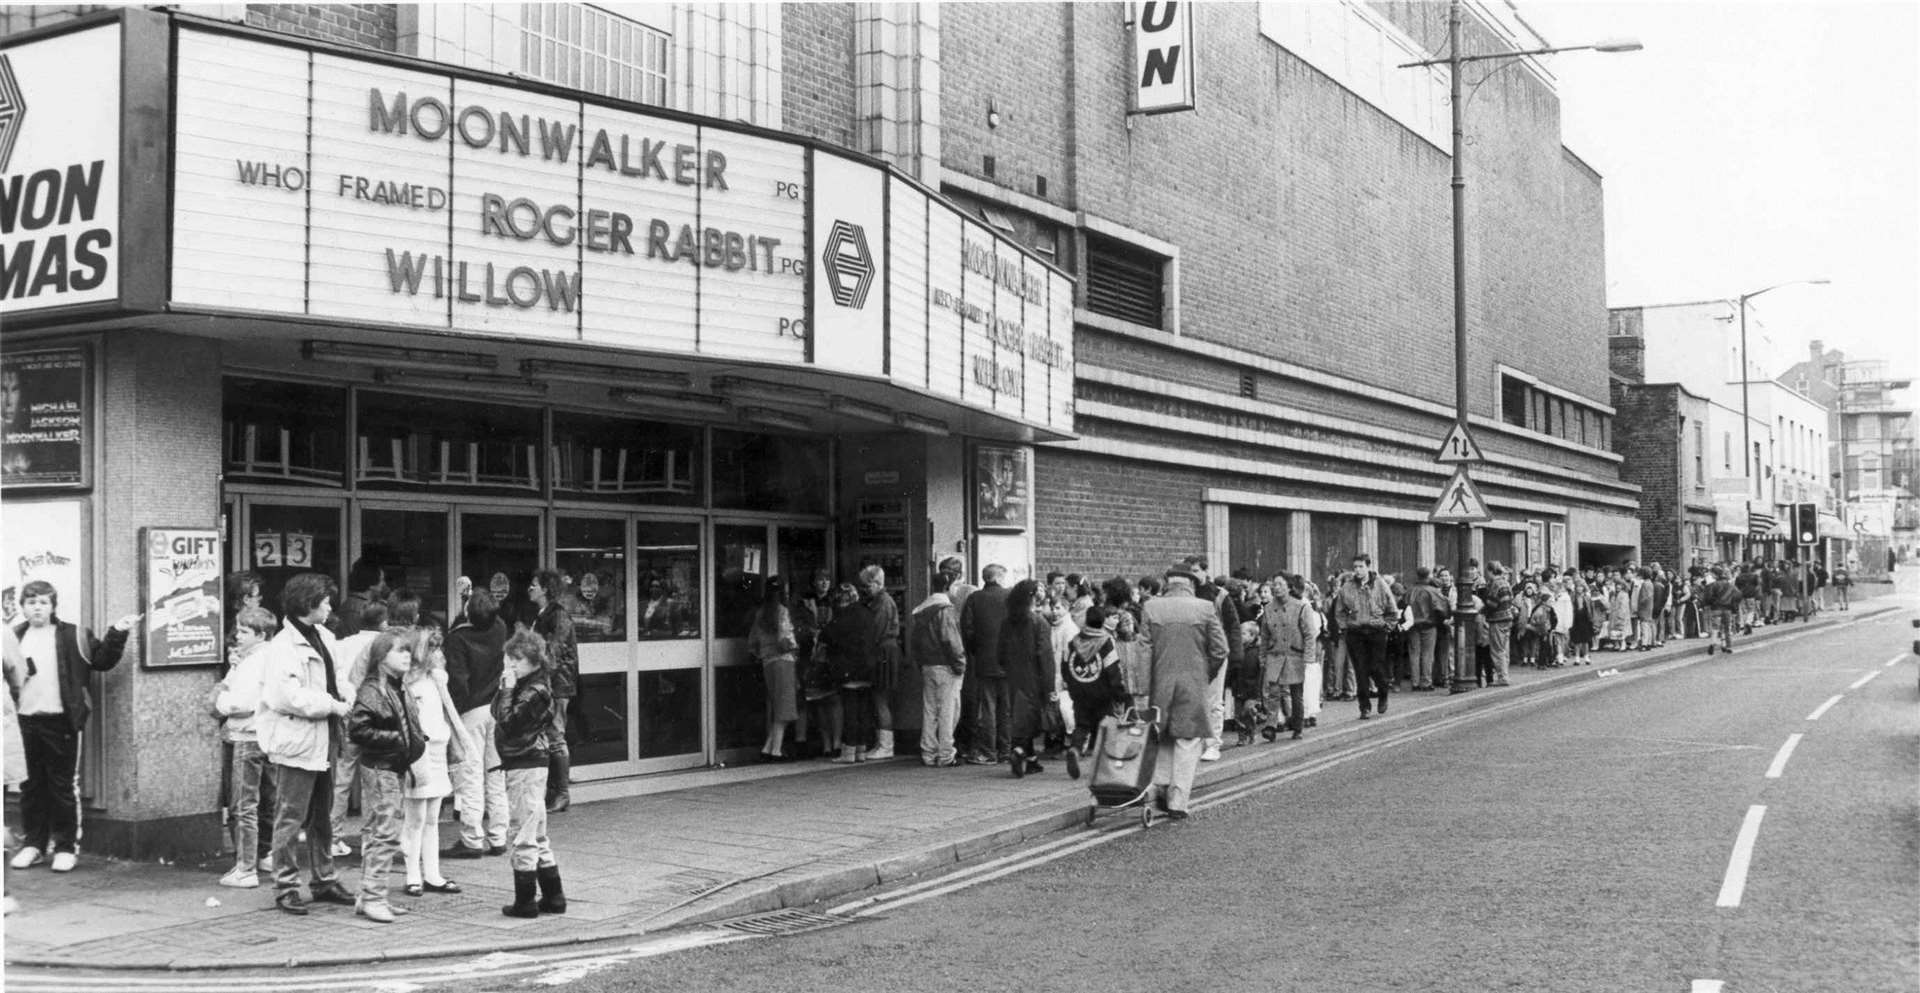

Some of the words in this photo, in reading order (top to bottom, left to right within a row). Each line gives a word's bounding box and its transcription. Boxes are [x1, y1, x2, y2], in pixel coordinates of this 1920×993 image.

[369, 87, 729, 191] MOONWALKER
[776, 180, 800, 199] PG
[236, 159, 305, 192] WHO
[339, 174, 447, 210] FRAMED
[482, 191, 635, 255] ROGER
[648, 218, 781, 275] RABBIT
[781, 257, 805, 276] PG
[385, 248, 581, 313] WILLOW
[172, 537, 217, 555] GIFT
[261, 541, 274, 565] 2
[293, 538, 307, 564] 3
